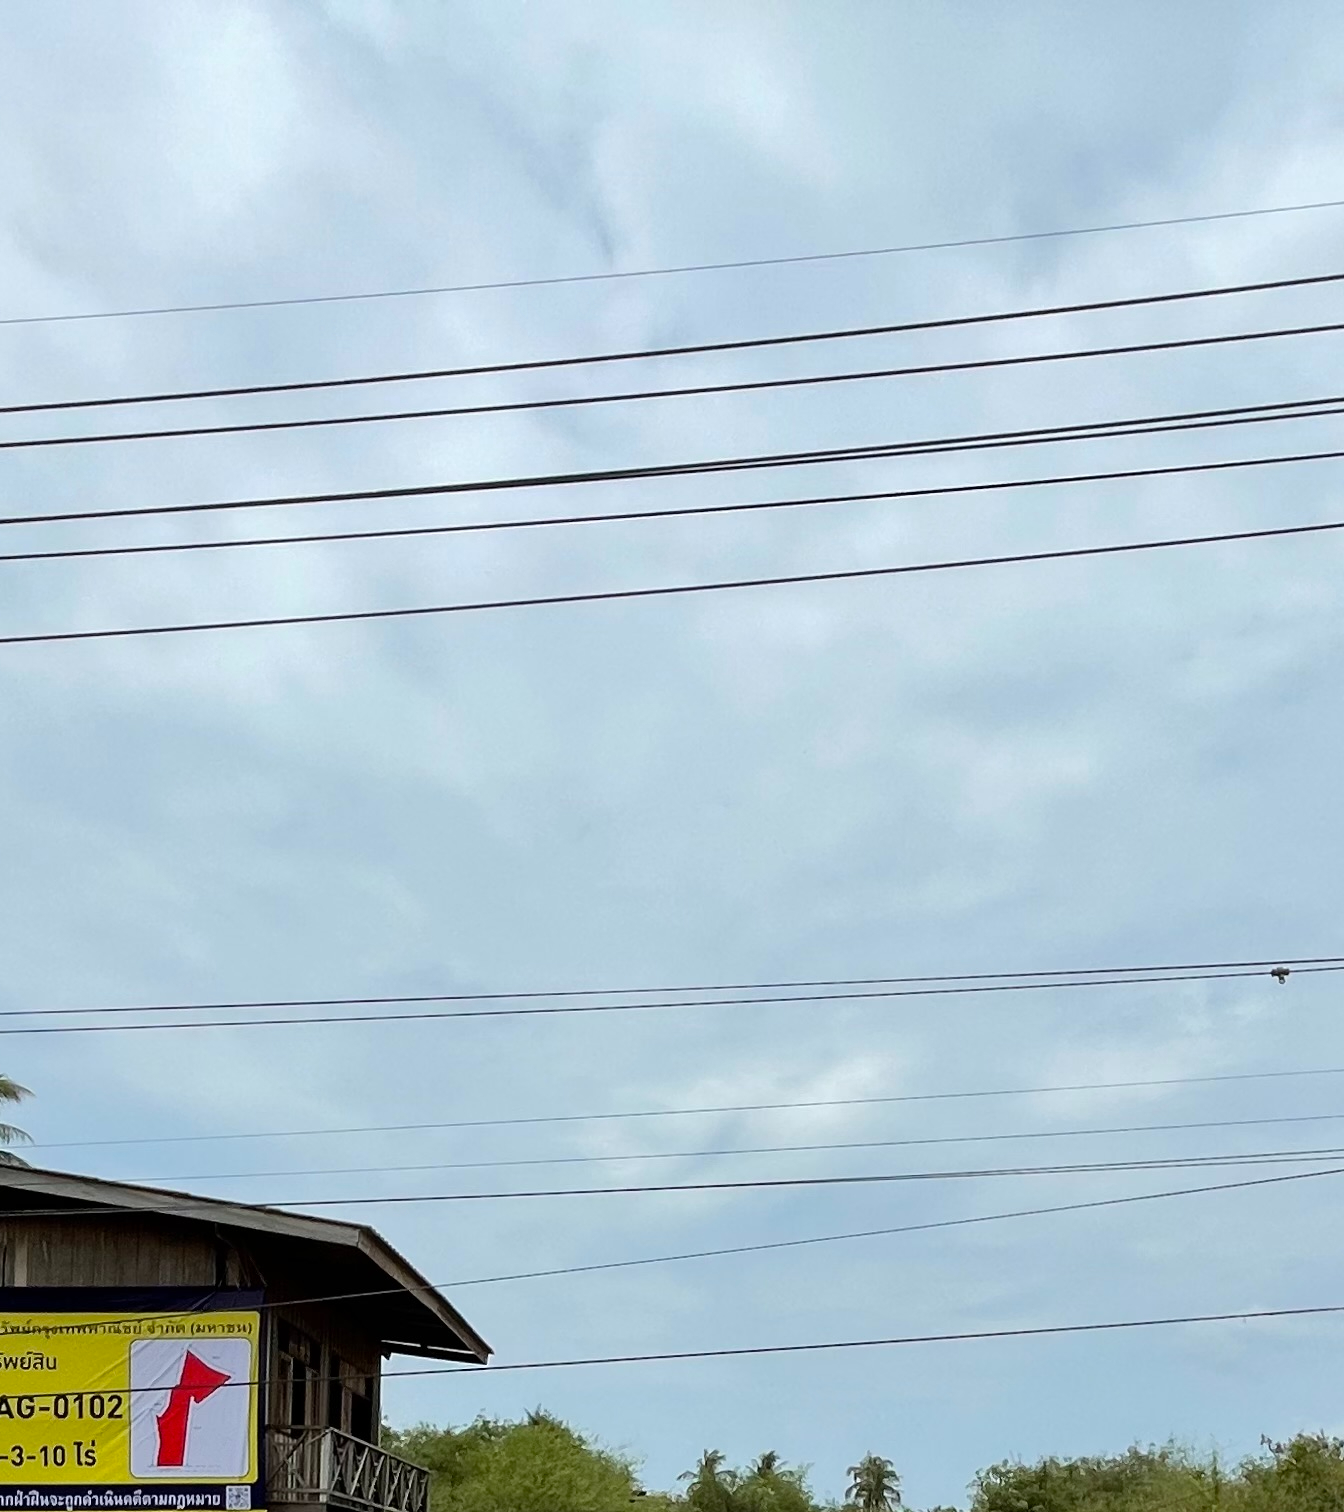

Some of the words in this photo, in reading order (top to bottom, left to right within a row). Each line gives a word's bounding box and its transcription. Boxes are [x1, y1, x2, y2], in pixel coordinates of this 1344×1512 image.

[147, 1319, 186, 1335] จำกัด
[190, 1322, 253, 1335] (มหาชน)
[73, 1440, 97, 1467] ไร่
